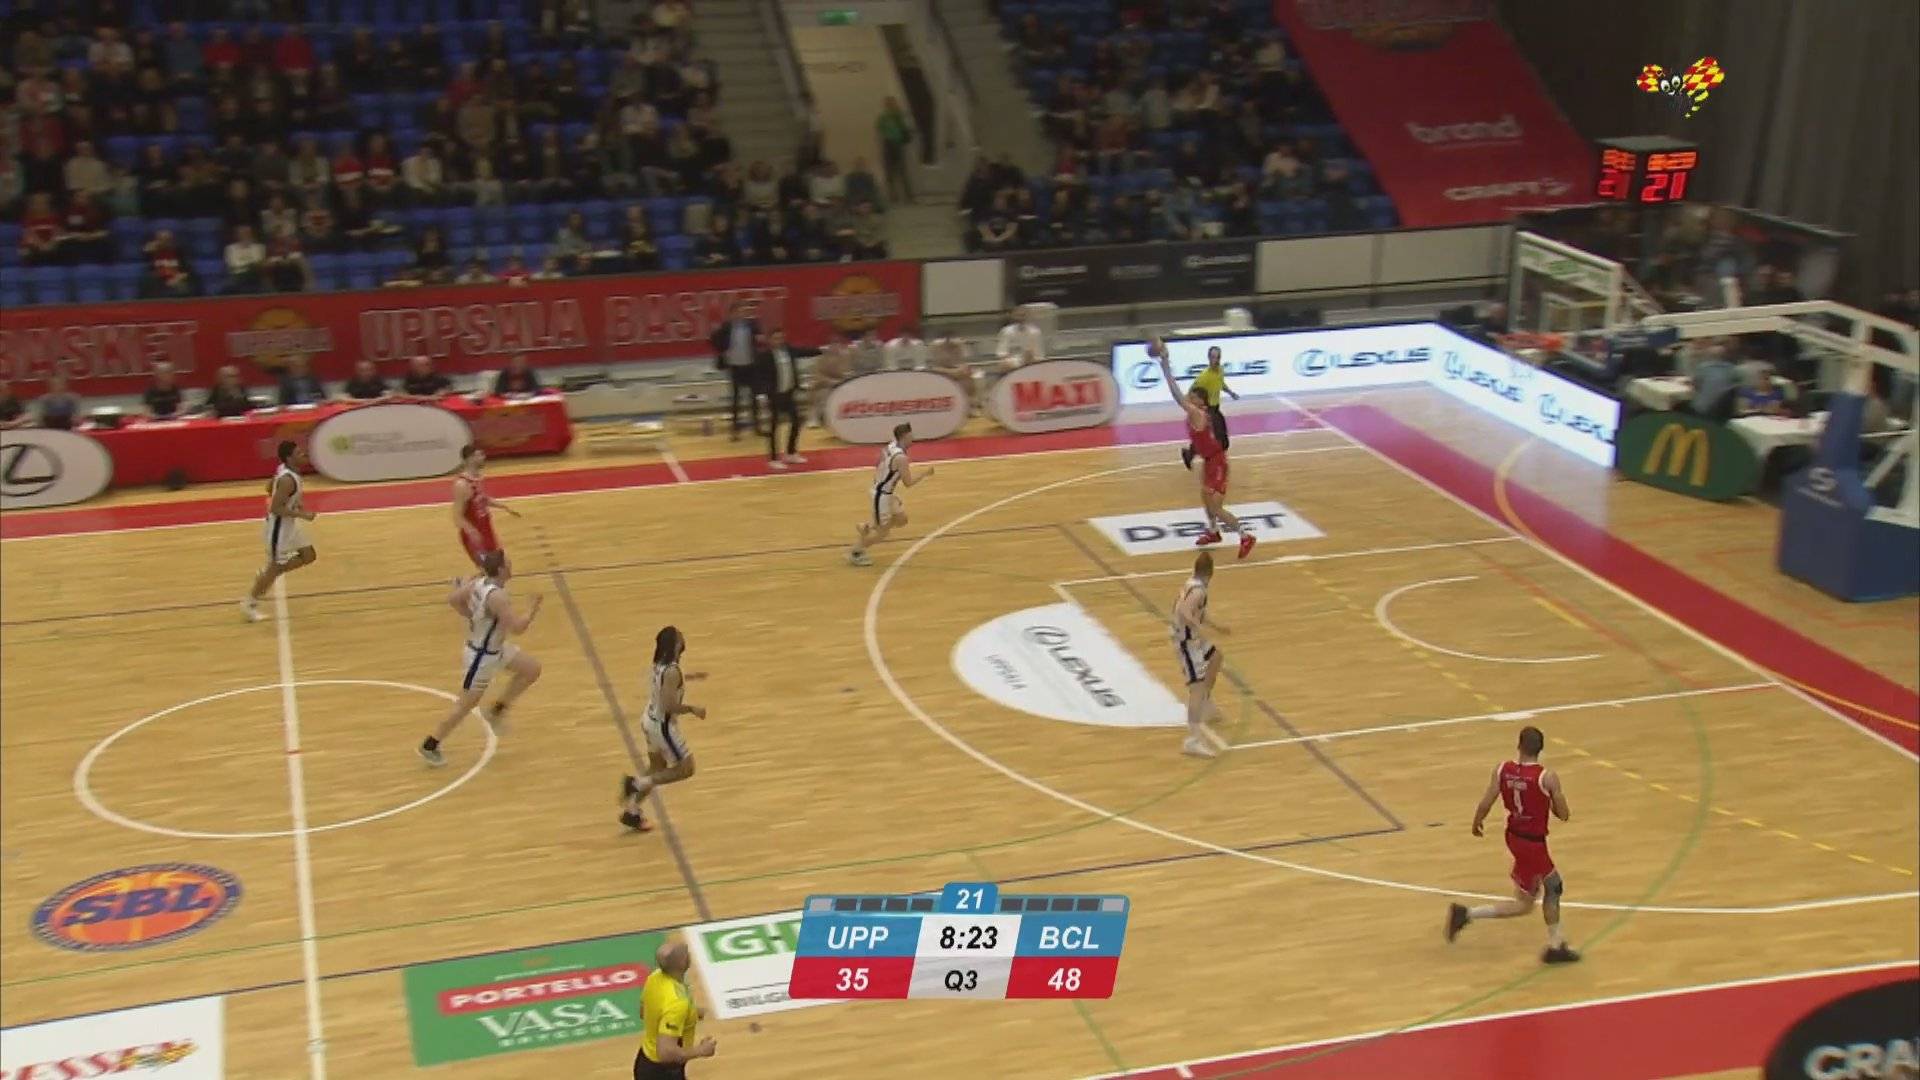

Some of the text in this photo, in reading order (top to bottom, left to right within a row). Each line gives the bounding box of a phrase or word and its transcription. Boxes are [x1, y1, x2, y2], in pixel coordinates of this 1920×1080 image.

[1641, 172, 1687, 202] 21
[359, 299, 588, 361] UPPSALA
[1330, 346, 1431, 368] LEXUS
[1013, 380, 1104, 414] MAXI
[1049, 645, 1126, 707] LEXUS
[62, 882, 213, 927] SBL
[449, 969, 640, 1009] PORTELLO
[476, 998, 630, 1038] VASA
[1804, 1036, 1920, 1080] CRA
